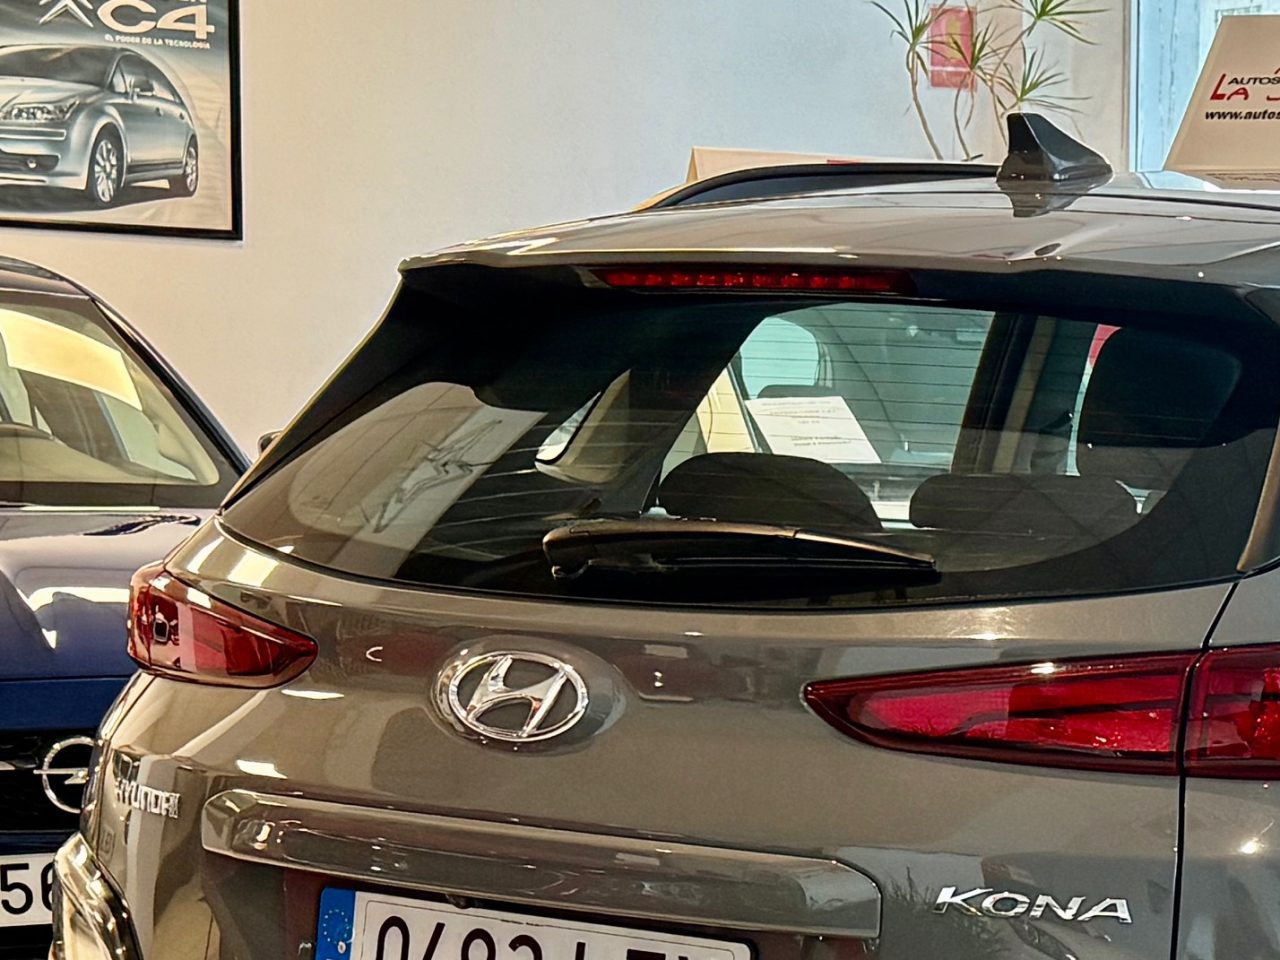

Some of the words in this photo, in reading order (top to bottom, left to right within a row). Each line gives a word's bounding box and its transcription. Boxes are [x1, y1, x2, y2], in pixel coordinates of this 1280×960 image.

[97, 0, 216, 40] C4
[153, 38, 163, 46] LA
[1209, 73, 1250, 101] LA
[114, 777, 181, 819] HYUNDAI
[932, 886, 1133, 924] KONA
